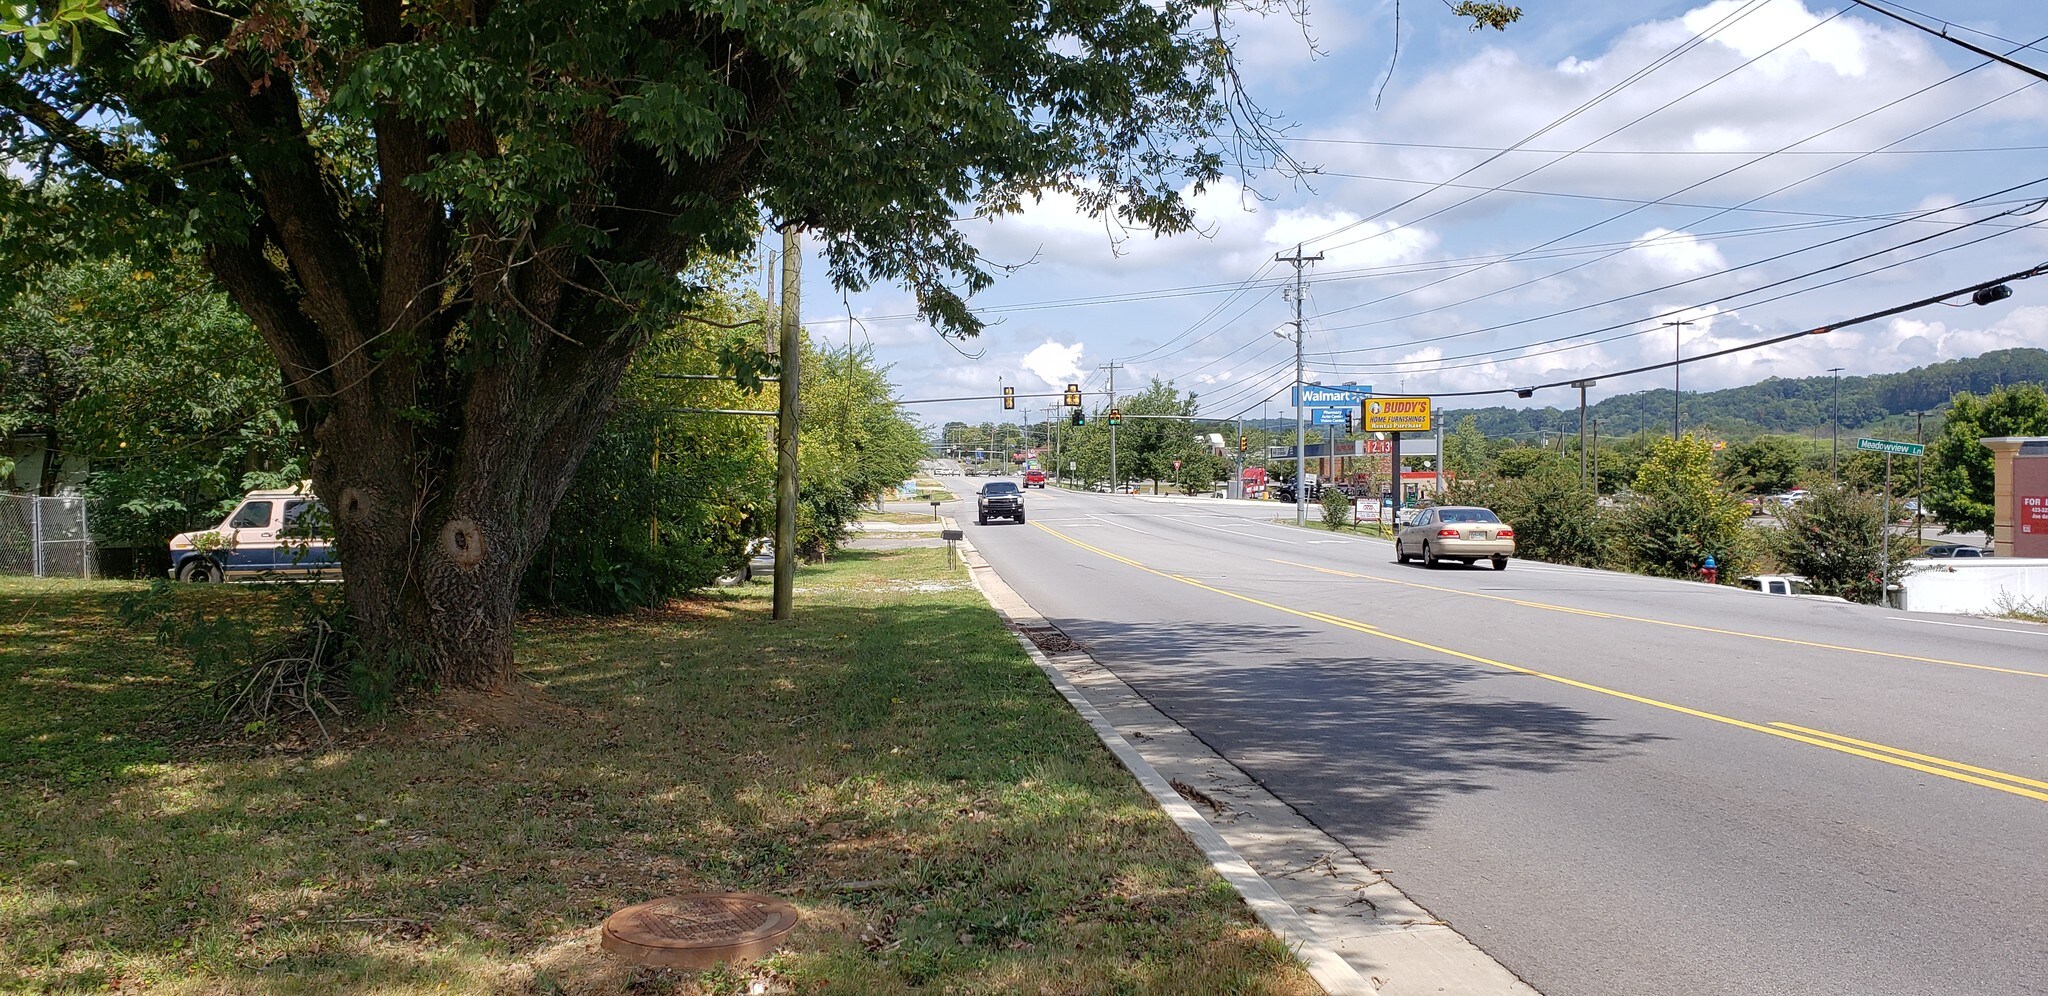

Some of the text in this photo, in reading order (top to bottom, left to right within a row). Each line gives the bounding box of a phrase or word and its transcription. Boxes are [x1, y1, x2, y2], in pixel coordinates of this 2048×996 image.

[1302, 390, 1350, 402] Walmart
[1383, 401, 1427, 414] BUDDY'S
[1387, 415, 1426, 423] FURNISHINGS
[1372, 441, 1392, 453] 2.13
[1861, 439, 1922, 455] Meadowview Ln
[2024, 498, 2041, 506] FOR
